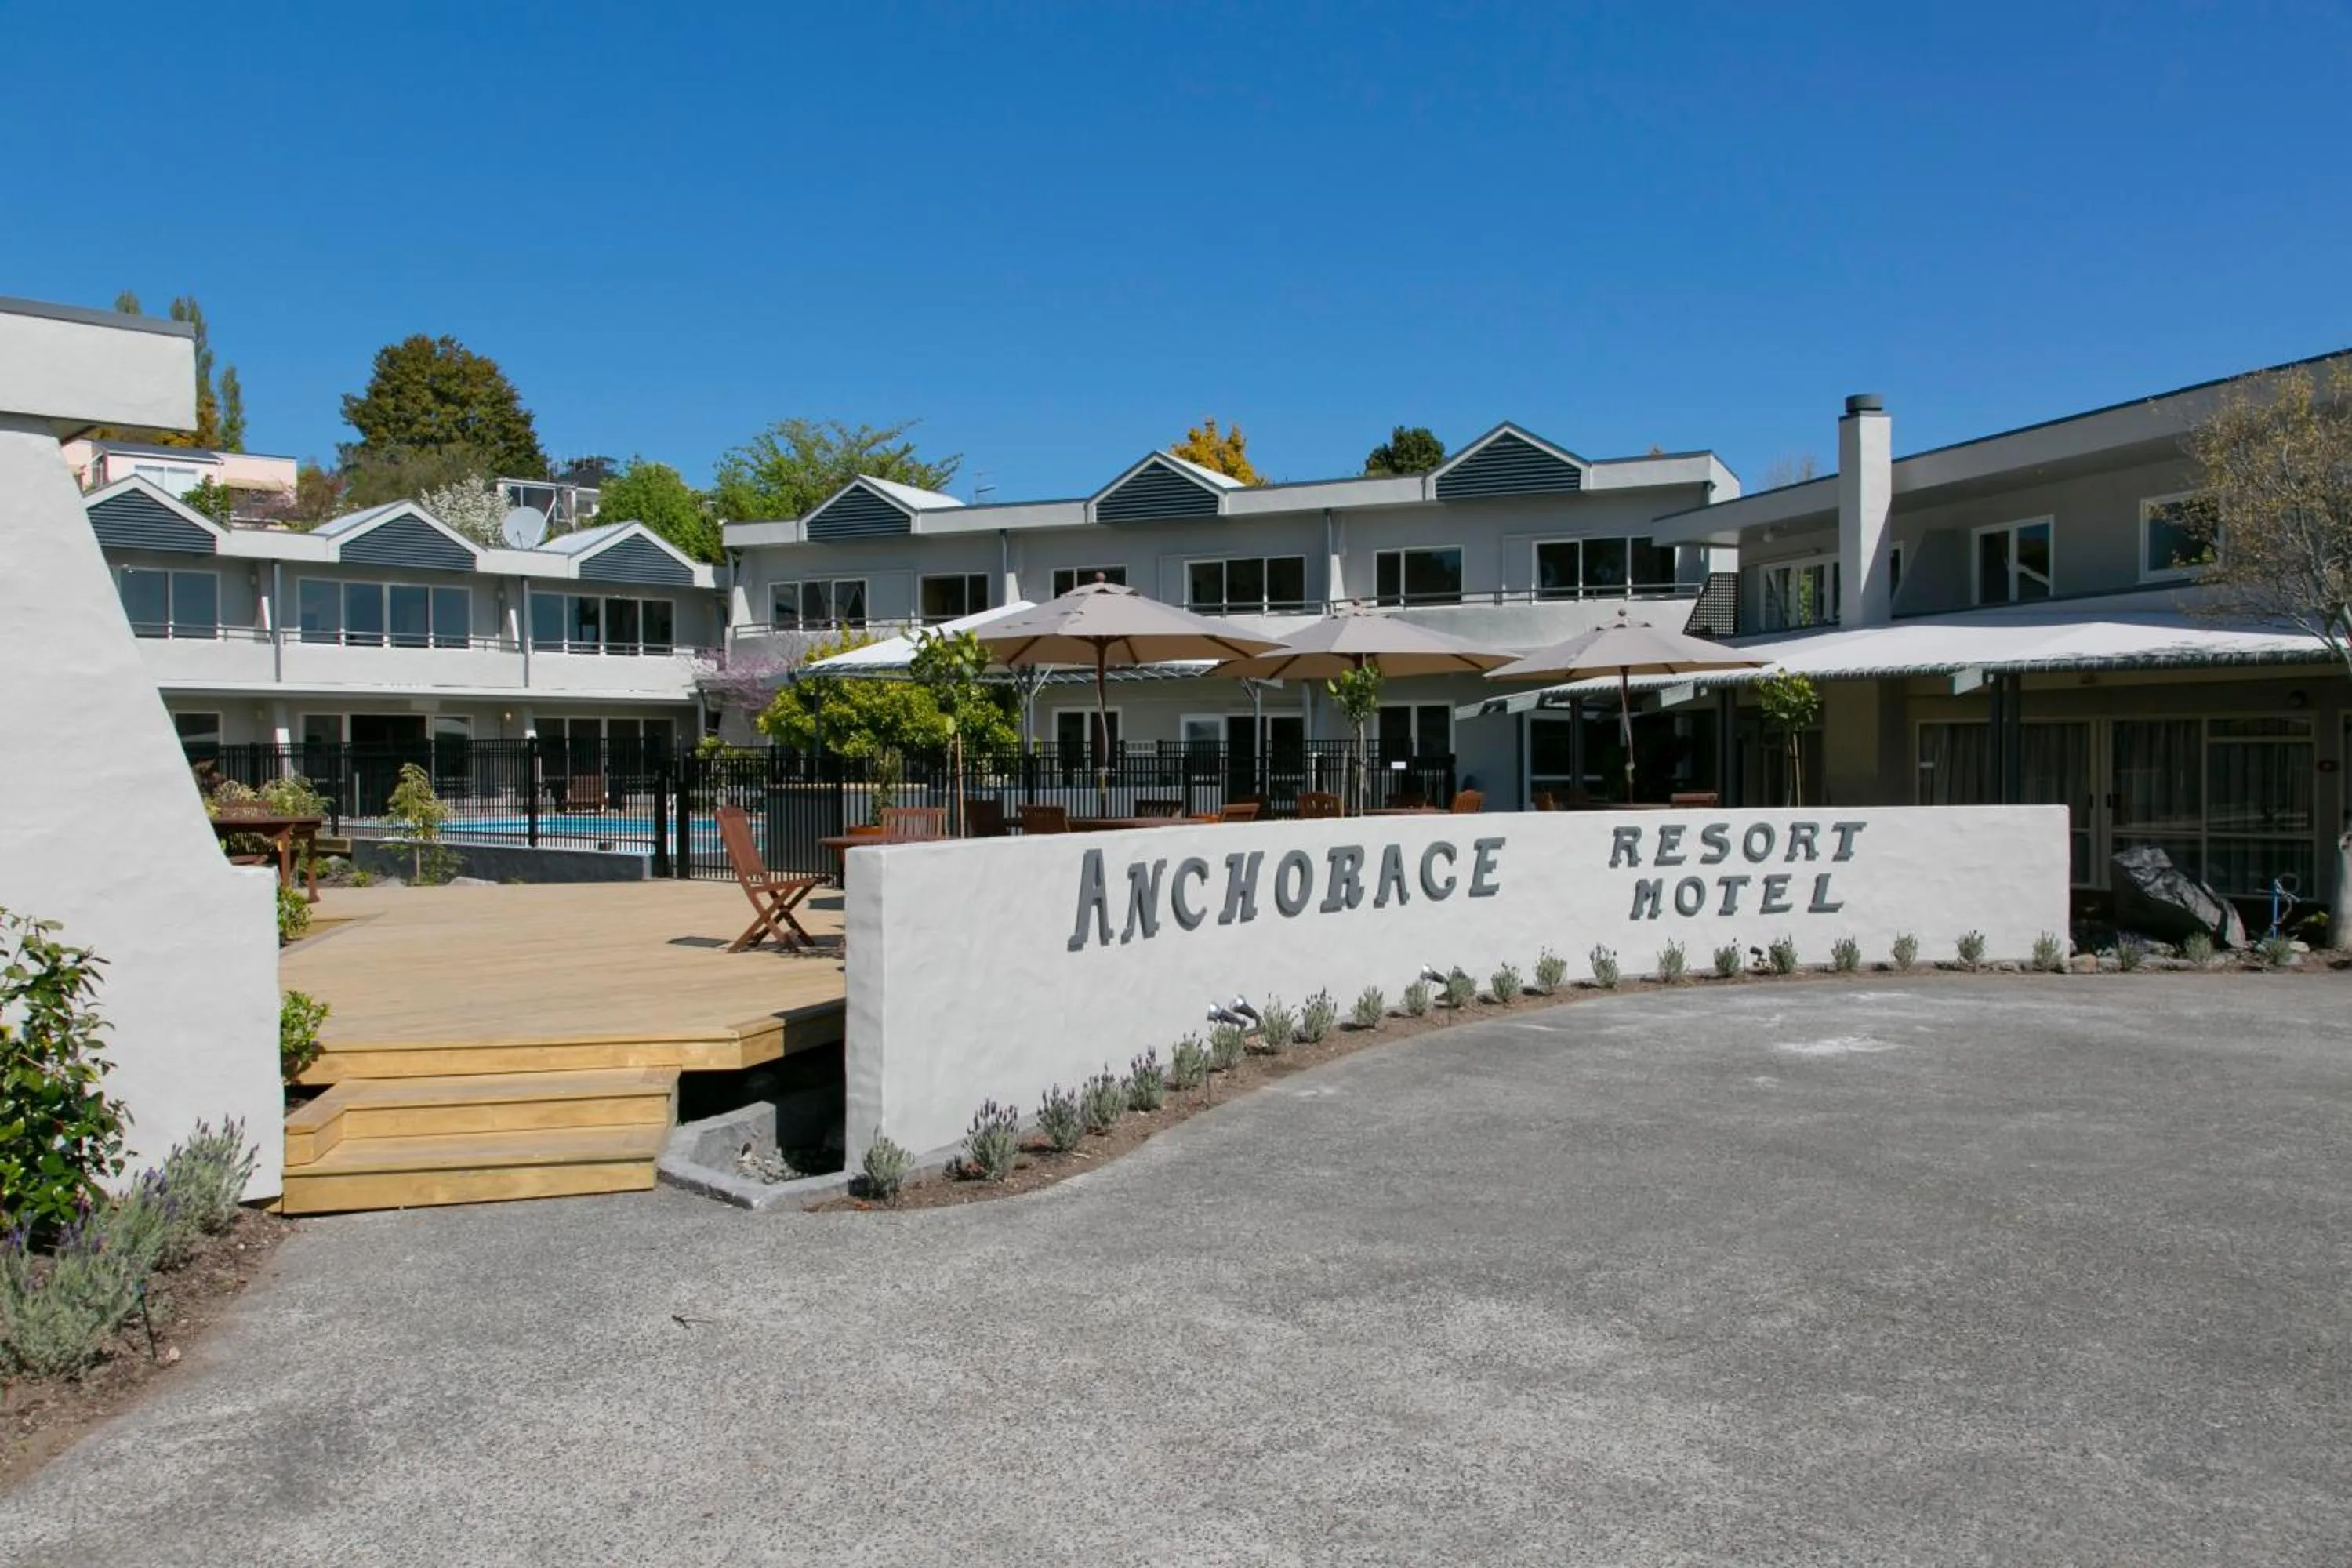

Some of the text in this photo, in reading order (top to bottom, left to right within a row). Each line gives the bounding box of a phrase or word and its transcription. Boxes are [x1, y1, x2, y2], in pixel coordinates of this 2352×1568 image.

[1609, 821, 1867, 868] RESORT
[1067, 837, 1506, 953] ANCHORAGE
[1630, 873, 1845, 920] MOTEL
